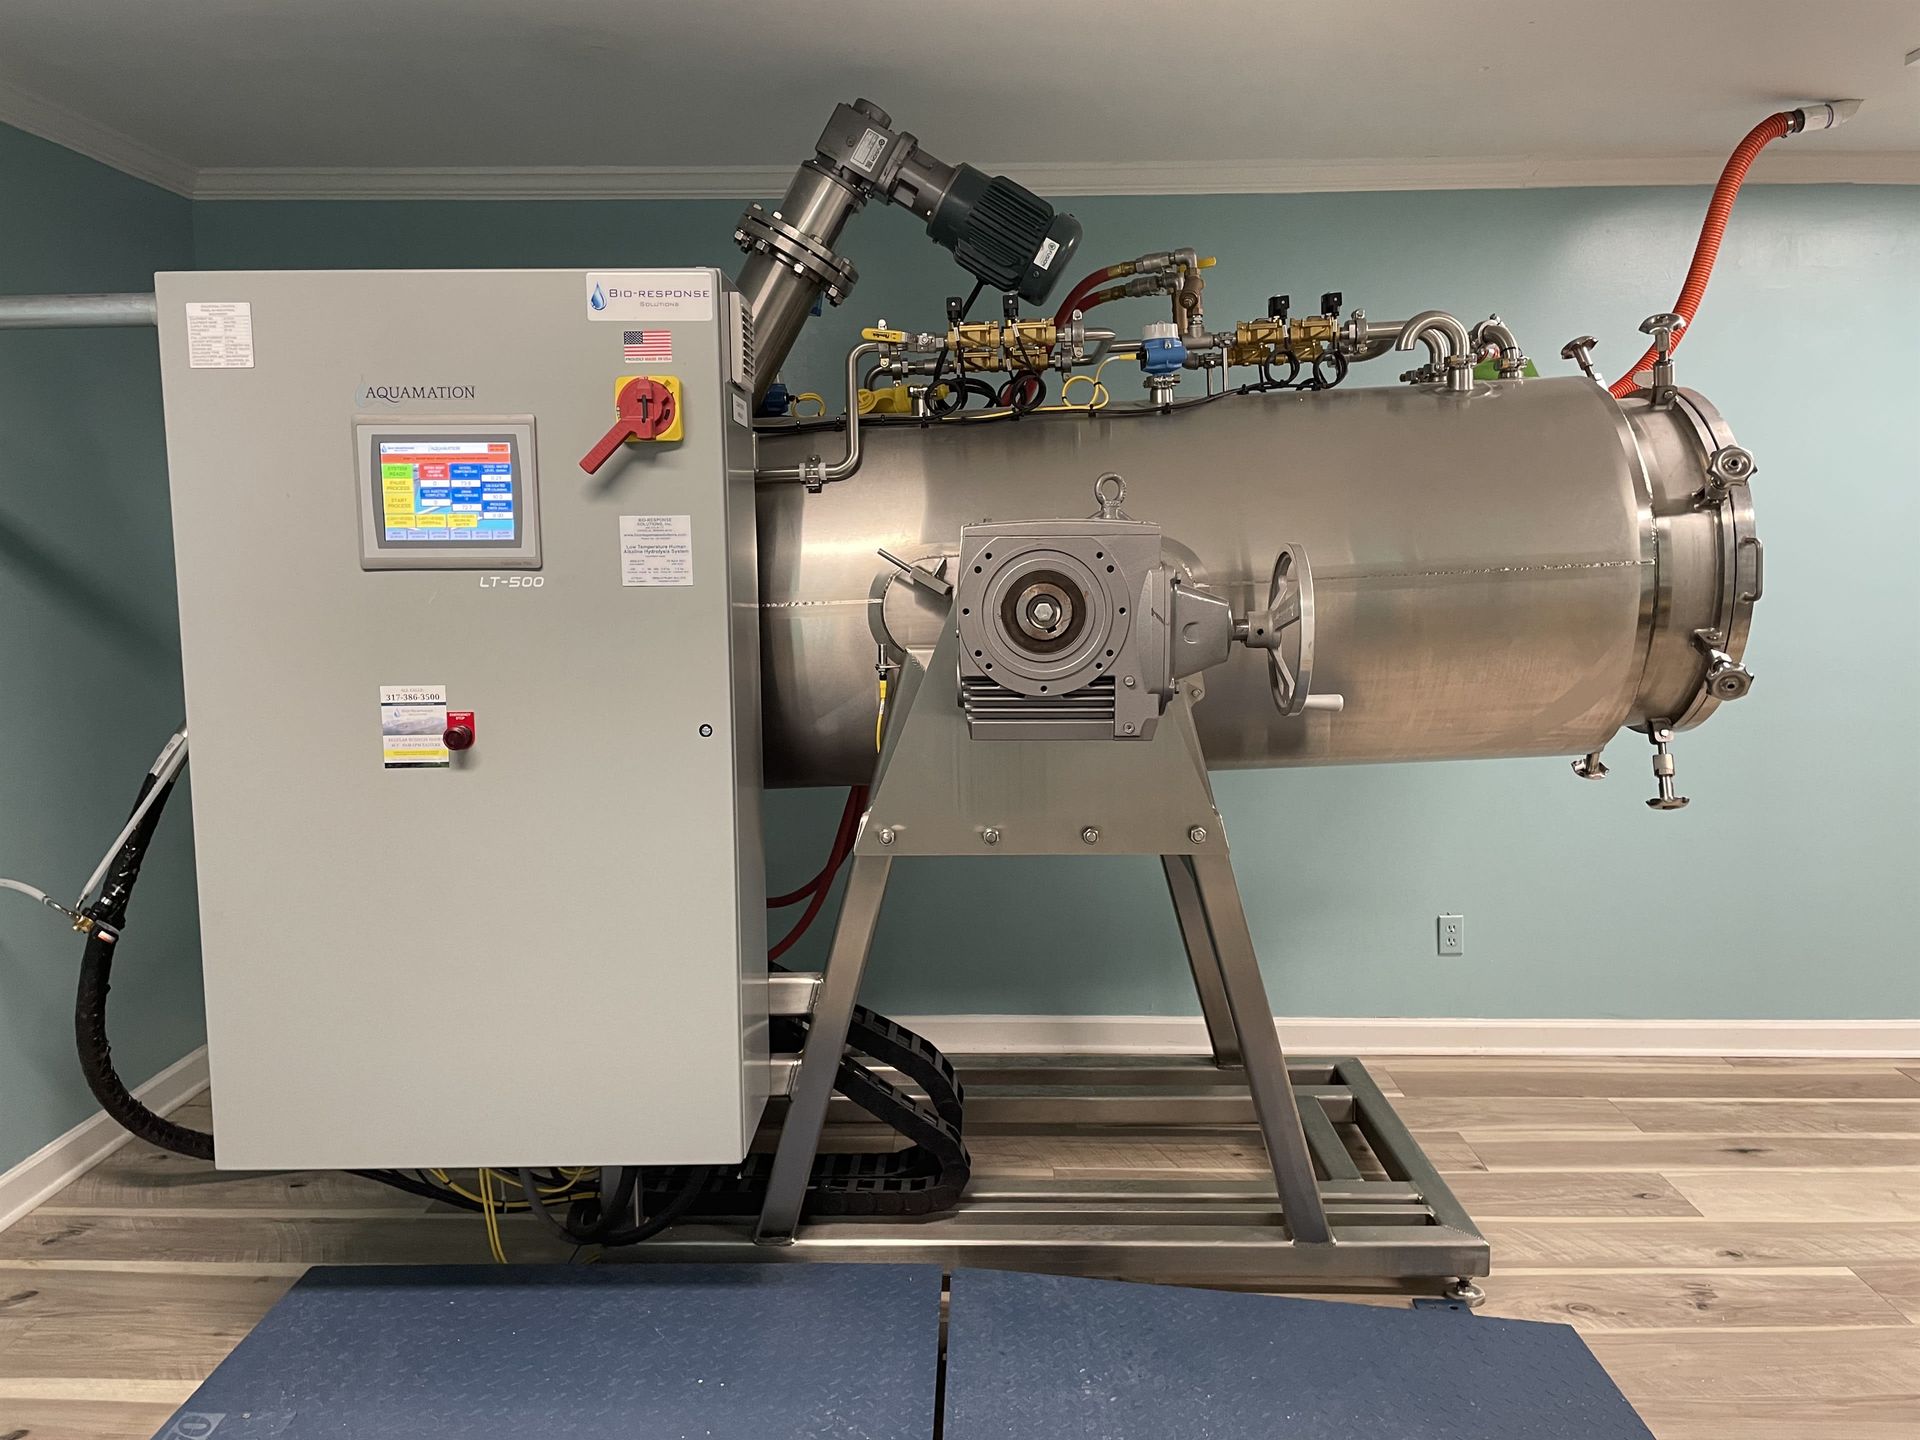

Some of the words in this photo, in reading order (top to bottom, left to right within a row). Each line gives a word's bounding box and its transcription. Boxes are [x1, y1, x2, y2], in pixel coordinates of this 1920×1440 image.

[366, 386, 476, 403] AQUAMATION
[480, 576, 545, 588] LT-500
[386, 693, 440, 701] 317-386-3500
